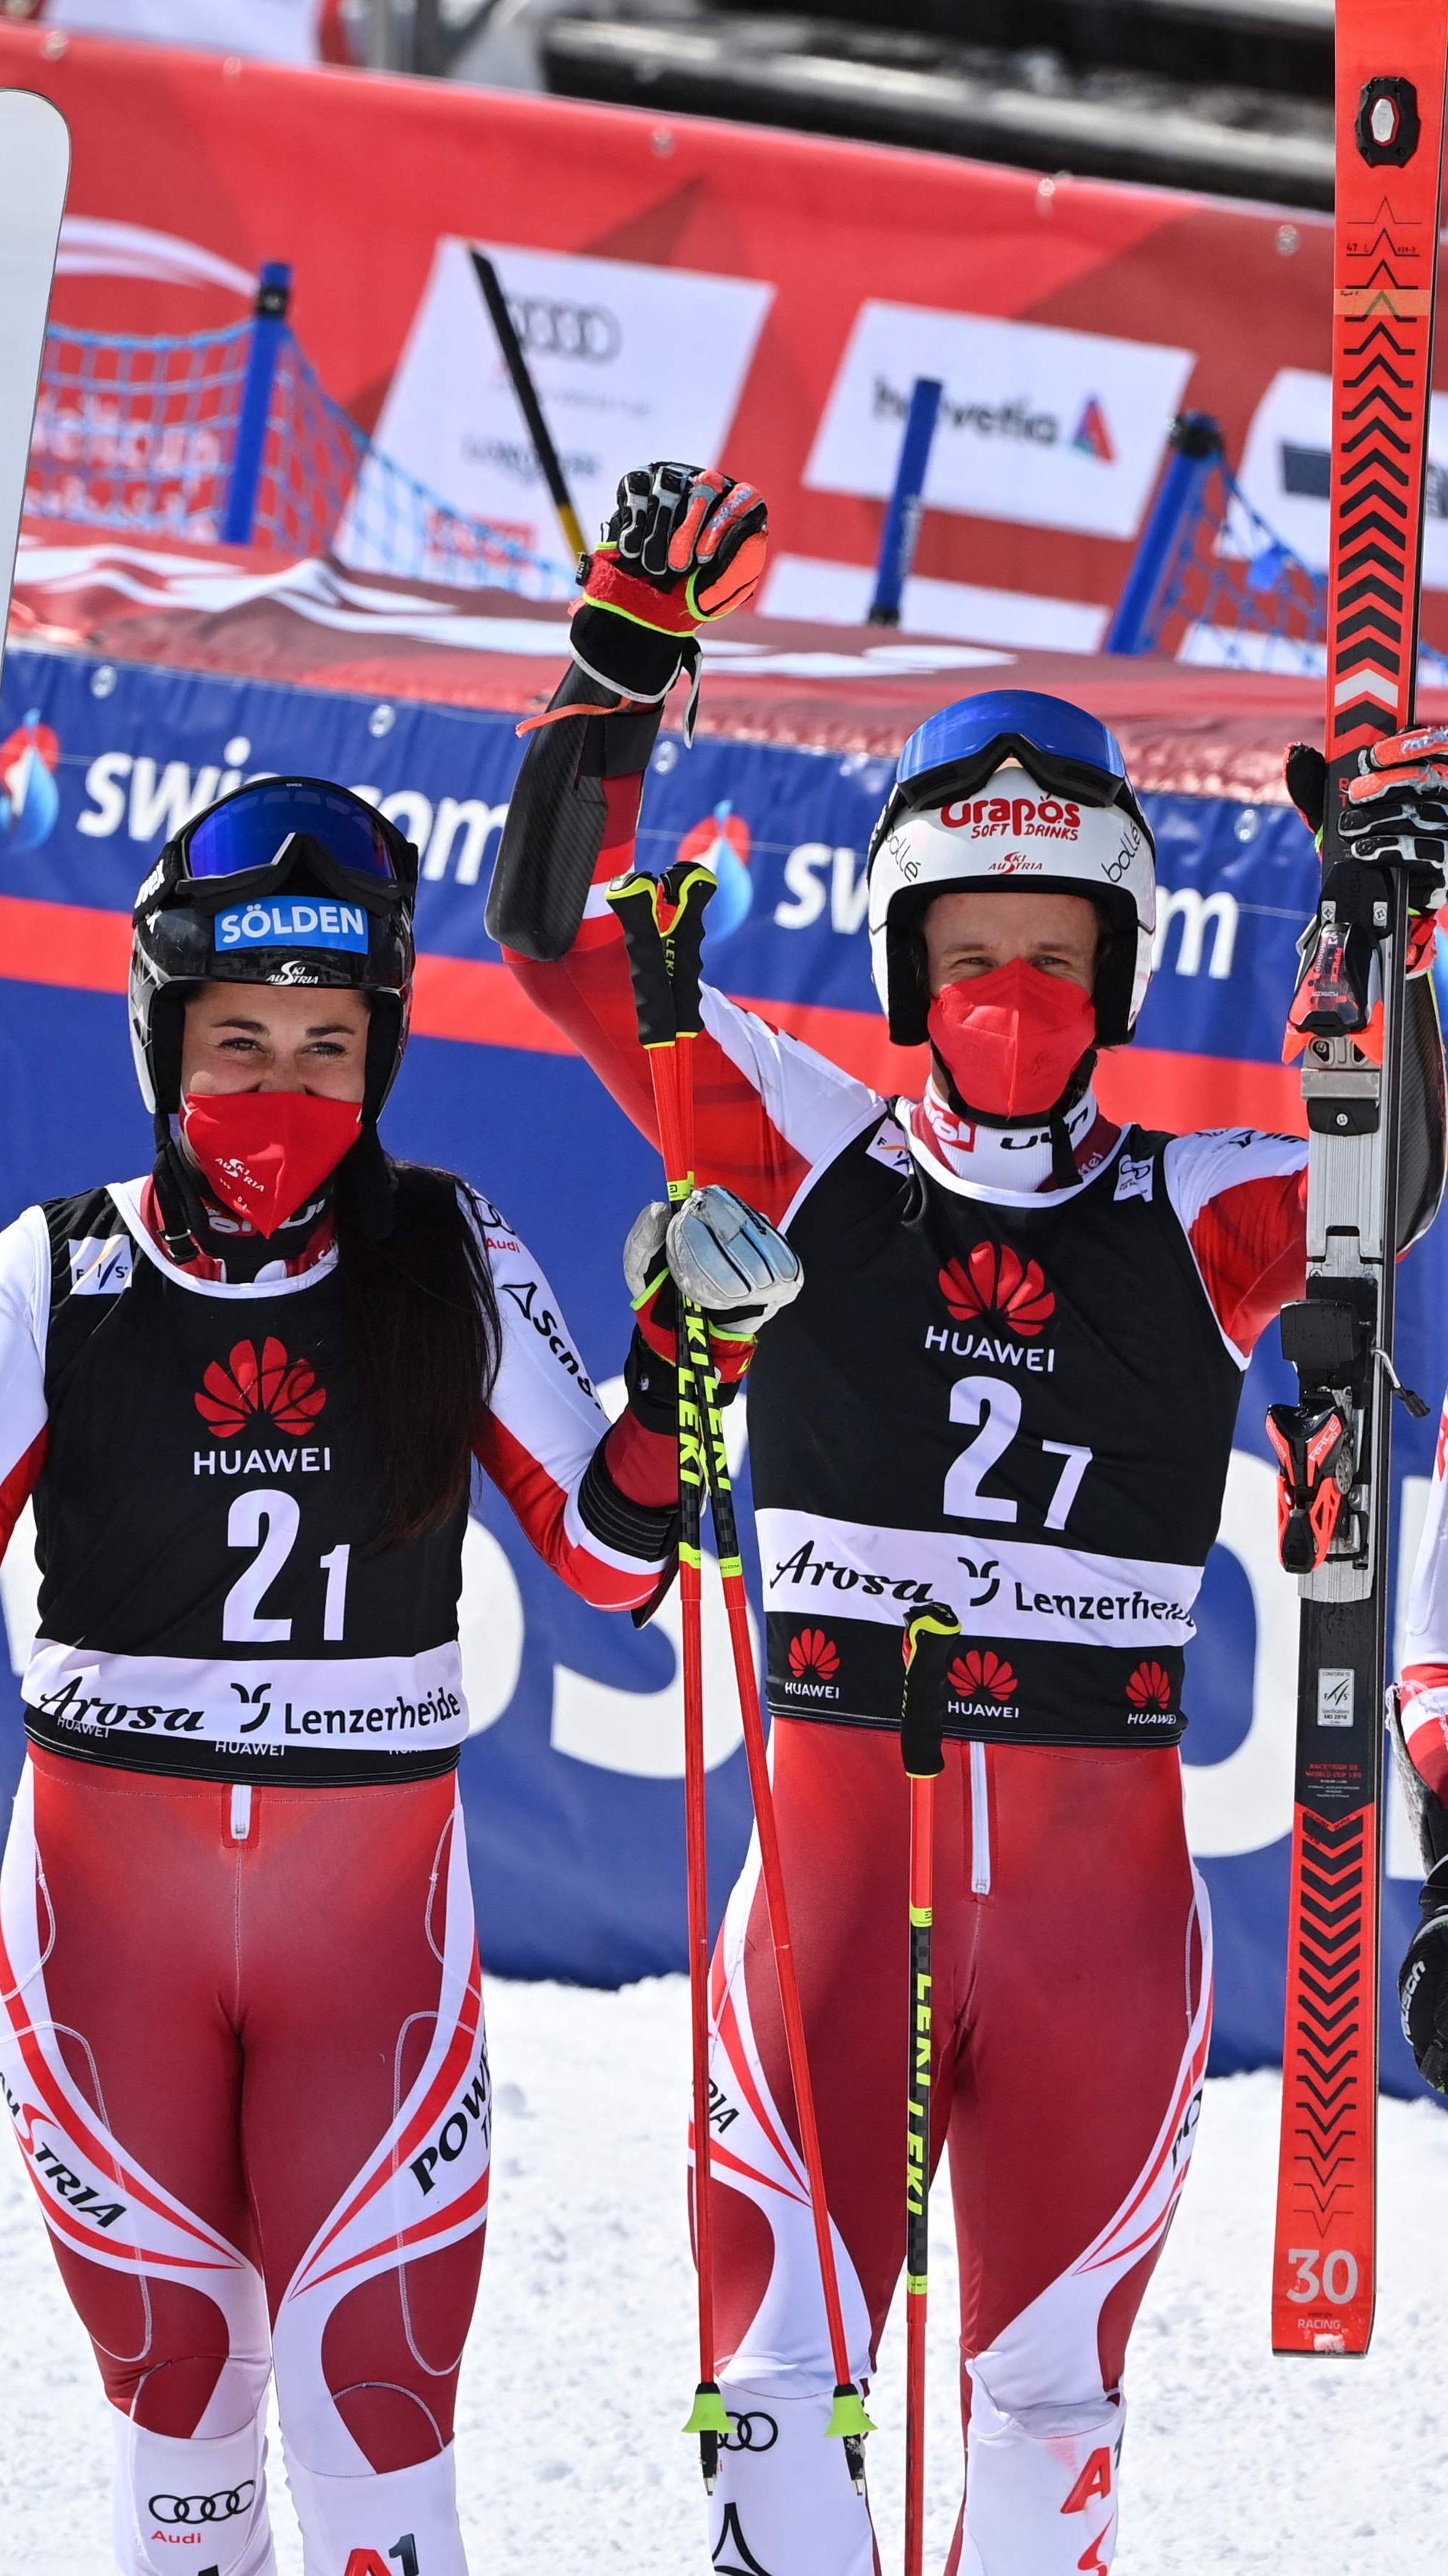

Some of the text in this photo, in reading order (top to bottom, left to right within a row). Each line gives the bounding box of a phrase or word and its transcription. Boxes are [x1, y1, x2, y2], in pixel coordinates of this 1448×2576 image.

[971, 824, 1079, 841] SOFT DRINKS
[1101, 821, 1142, 884] bollé
[988, 859, 1043, 874] AUSTRIA
[221, 903, 365, 944] SÖLDEN
[266, 972, 319, 985] AUSTRIA
[215, 1158, 265, 1193] AUSRIA
[485, 1237, 520, 1254] Audi
[924, 1324, 1056, 1372] HUAWEI
[678, 1367, 701, 1487] LEKI
[704, 1375, 732, 1492] LEKI
[1308, 1418, 1339, 1462] RACE
[194, 1447, 330, 1475] HUAWEI
[943, 1375, 1094, 1530] 27
[222, 1489, 351, 1644] 21
[769, 1540, 934, 1603] Arosa
[39, 1676, 461, 1734] Arosa Lenzerheide
[785, 1681, 840, 1700] HUAWEI
[948, 1700, 1021, 1719] HUAWEI
[215, 1740, 286, 1757] HUAWEI
[916, 1973, 932, 2087] LEKI
[907, 2098, 925, 2216] LEKI
[1287, 2248, 1359, 2305] 30
[1298, 2319, 1341, 2329] RACING
[151, 2530, 202, 2545] Audi
